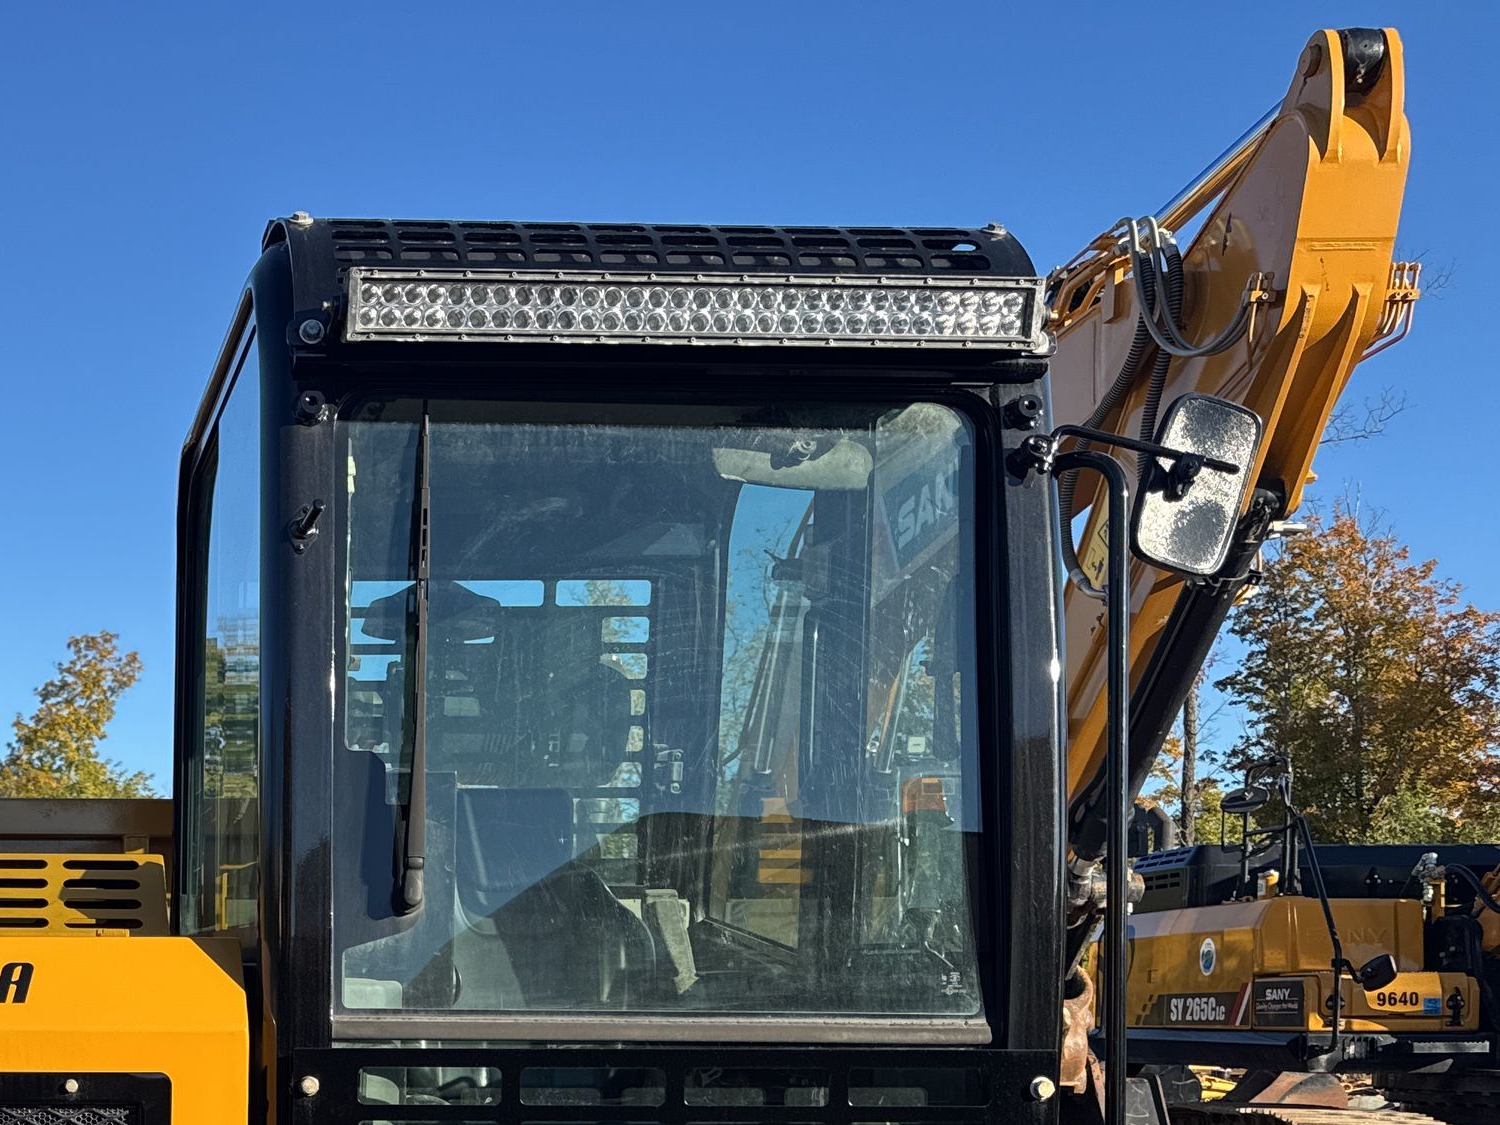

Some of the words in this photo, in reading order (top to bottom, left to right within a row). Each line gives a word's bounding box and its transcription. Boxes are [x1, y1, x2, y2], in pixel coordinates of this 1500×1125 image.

[895, 457, 959, 550] SAN
[1307, 928, 1388, 944] NY
[1265, 988, 1291, 1000] SANY
[1377, 992, 1419, 1007] 9640
[1170, 998, 1184, 1021] SY
